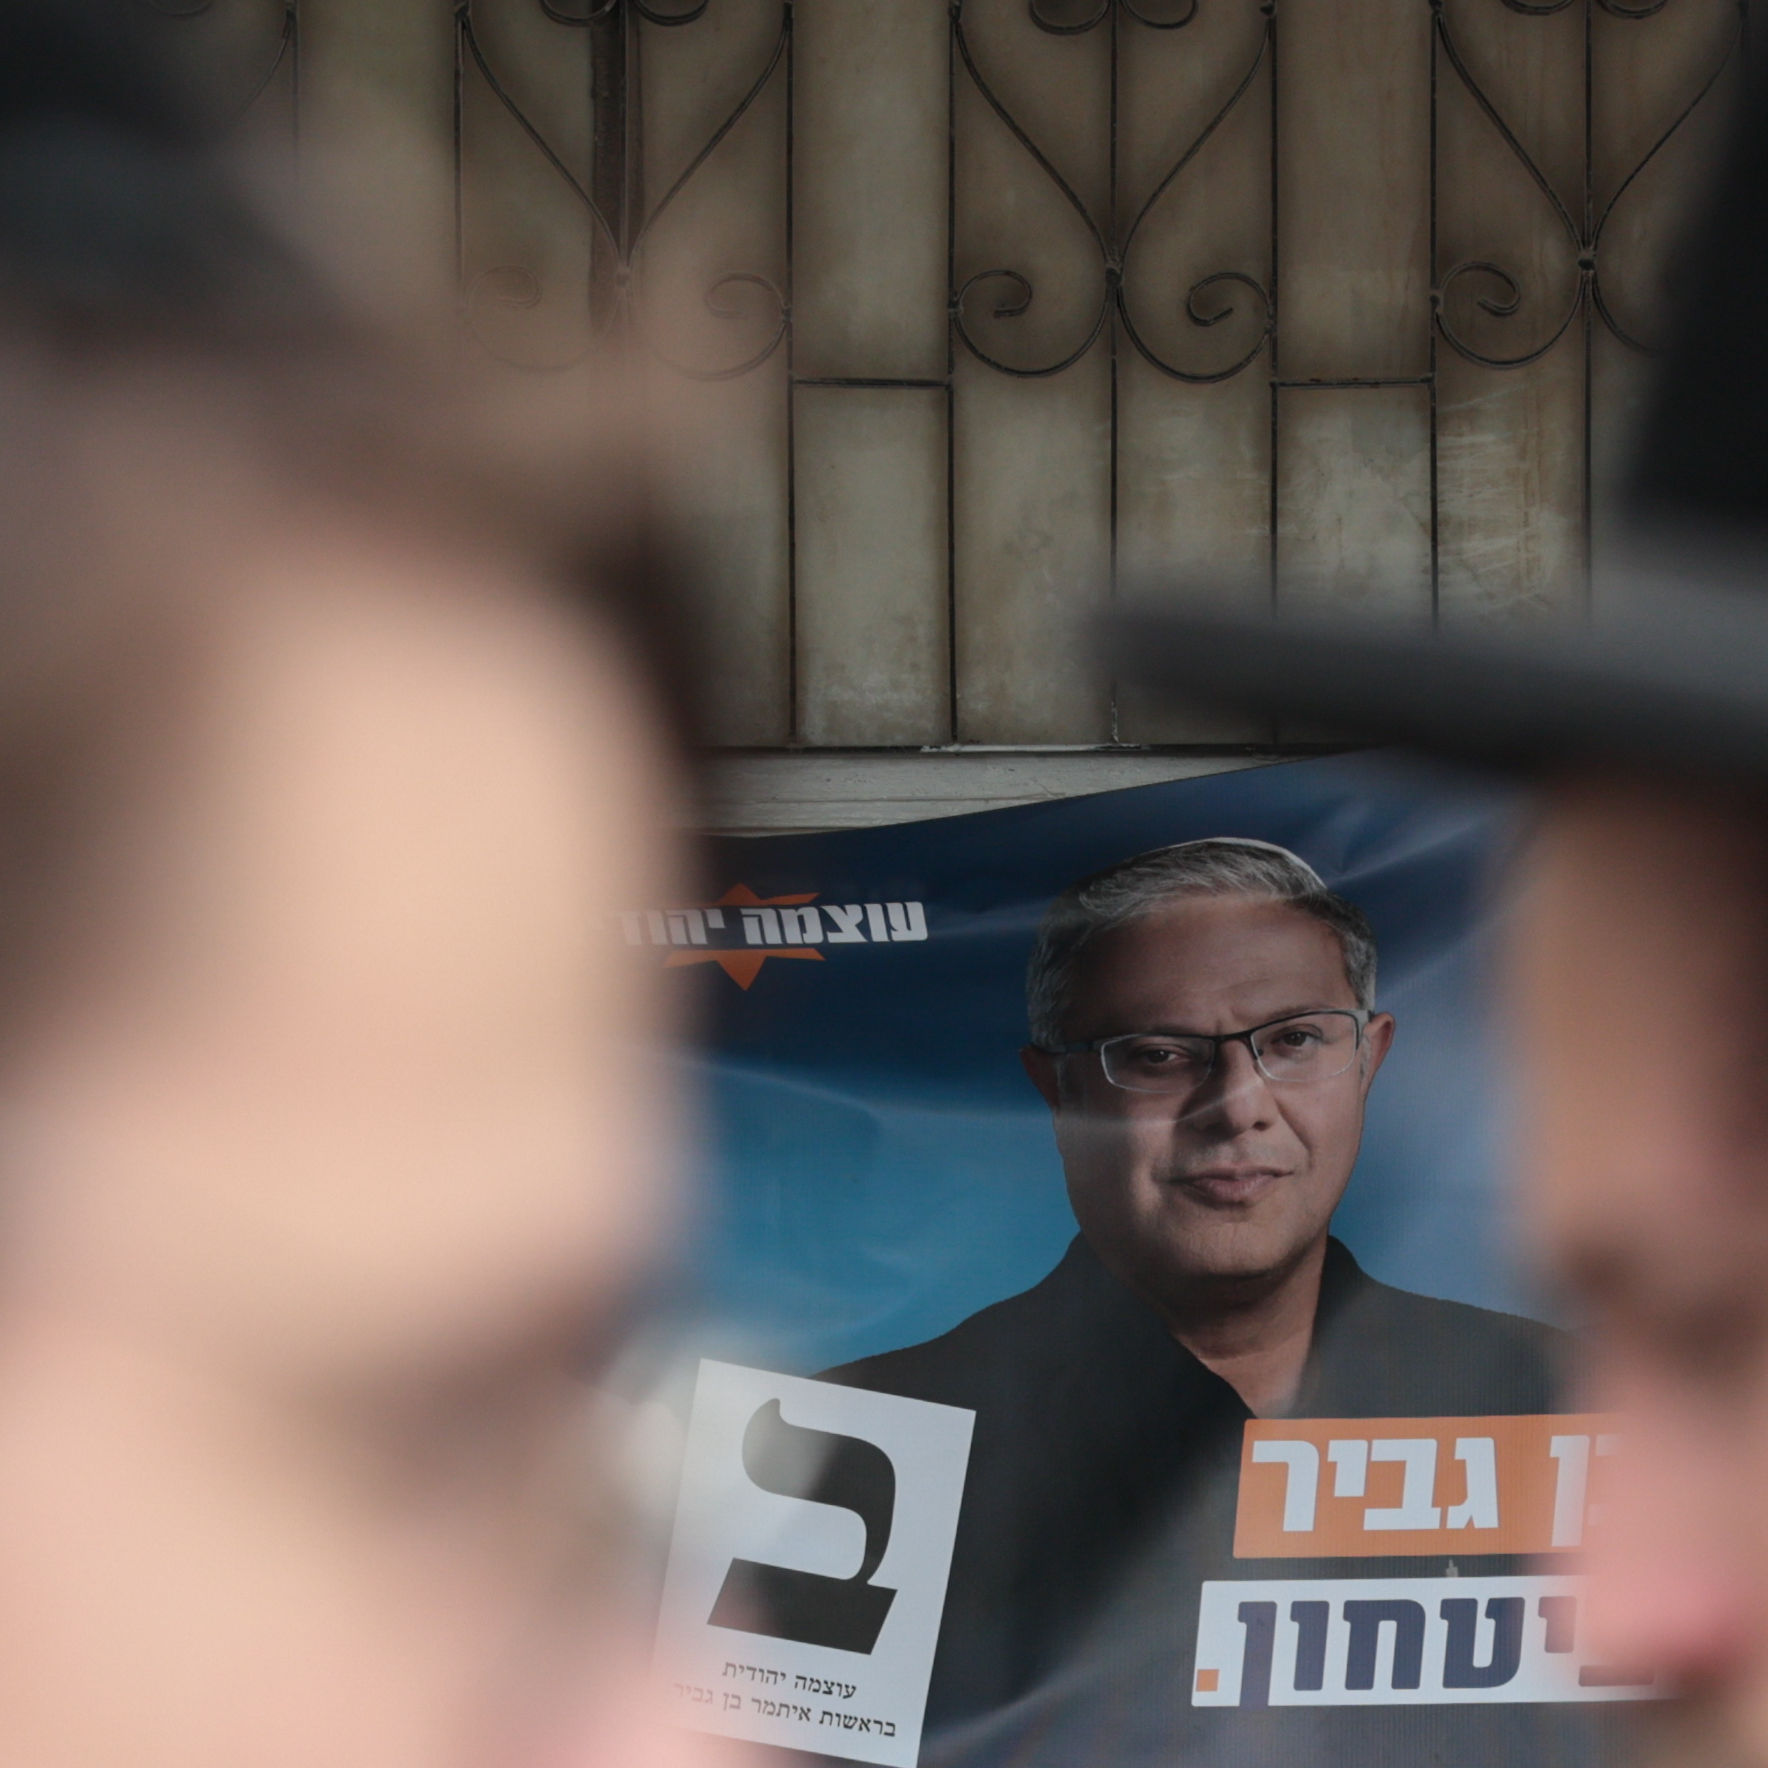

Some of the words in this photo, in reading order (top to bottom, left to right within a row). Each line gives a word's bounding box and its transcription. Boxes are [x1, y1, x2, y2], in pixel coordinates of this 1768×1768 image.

[605, 908, 726, 945] יהוד
[740, 901, 928, 945] עוצמה
[1252, 1436, 1499, 1532] גביר
[706, 1398, 899, 1655] ב
[722, 1662, 787, 1685] יהודית
[794, 1674, 857, 1699] עוצמה
[672, 1682, 713, 1704] גביר
[722, 1692, 742, 1711] בן
[751, 1697, 812, 1722] איתמר
[818, 1710, 896, 1737] בראשות
